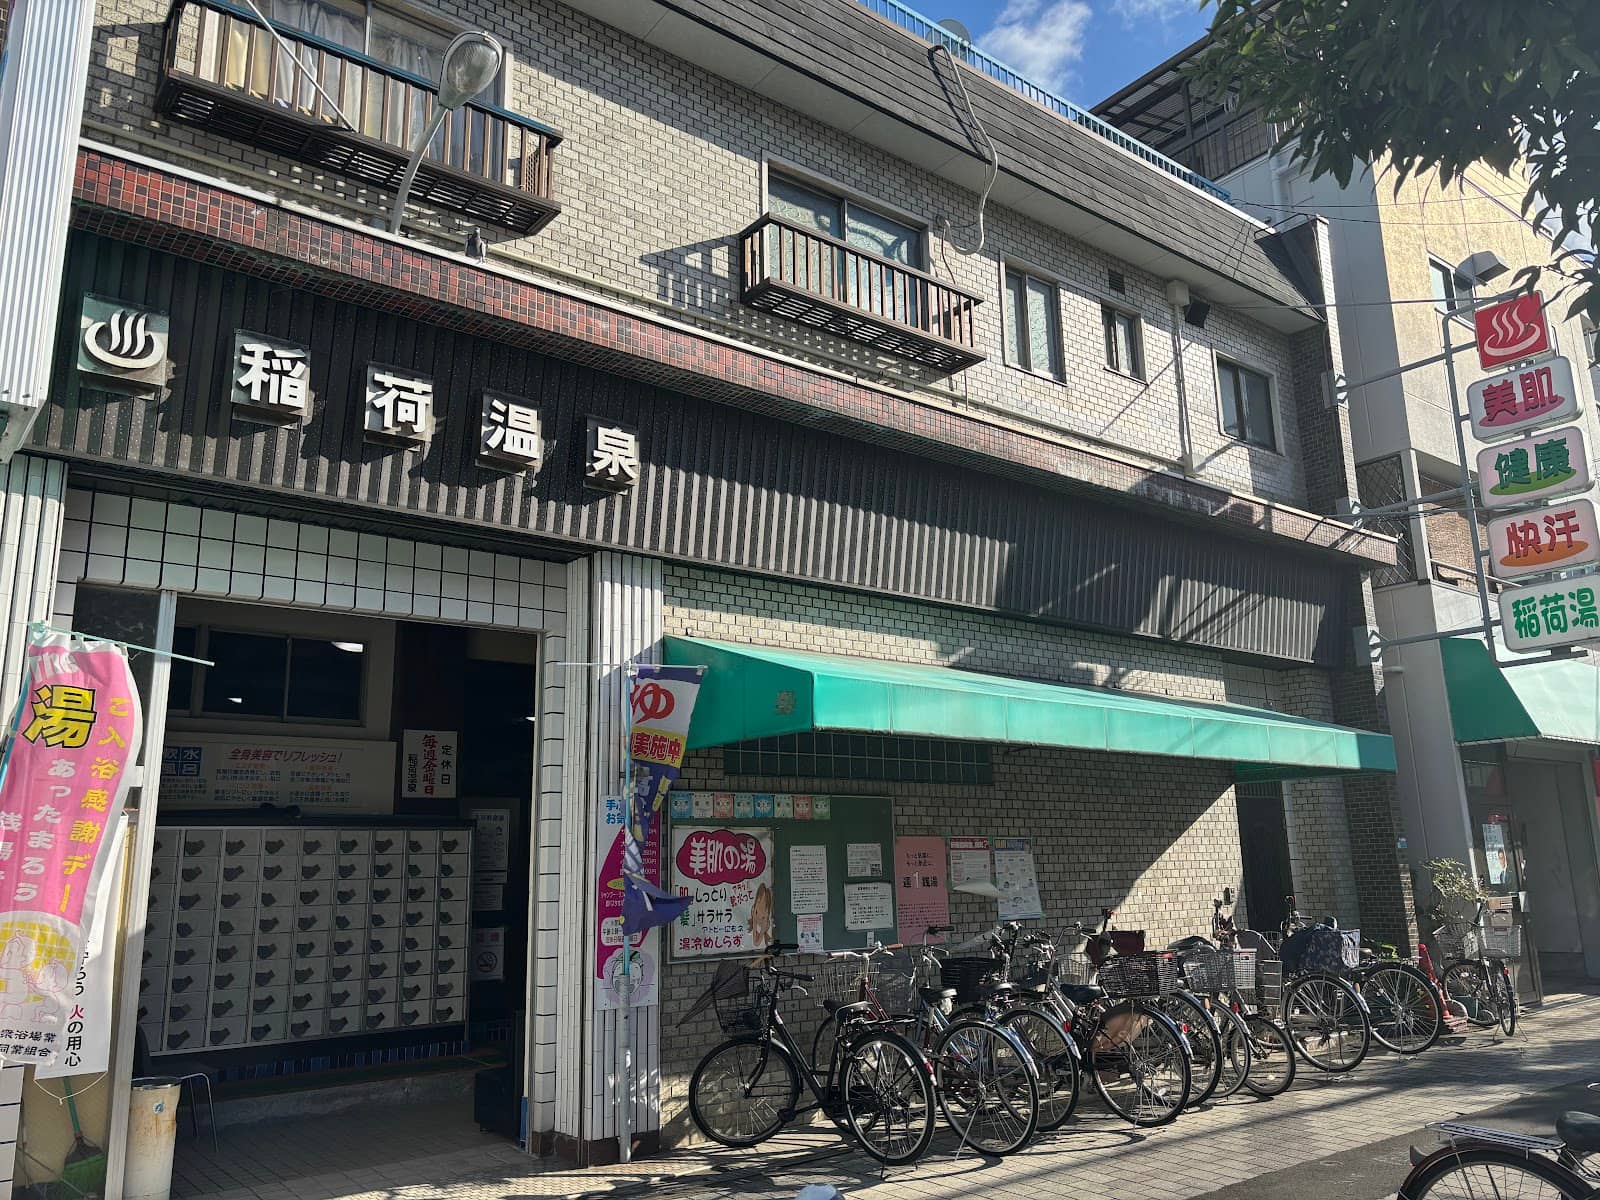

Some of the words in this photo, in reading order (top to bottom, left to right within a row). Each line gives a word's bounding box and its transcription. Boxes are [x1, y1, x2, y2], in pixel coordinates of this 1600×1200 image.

[237, 341, 640, 480] 稲荷温泉
[1482, 366, 1558, 423] 美肌
[1494, 437, 1573, 491] 健康
[1506, 509, 1581, 560] 快汗
[1511, 586, 1600, 640] 稲荷湯
[21, 684, 98, 749] 湯
[630, 682, 675, 724] ゆ
[440, 744, 453, 785] 定休日
[13, 758, 77, 902] あったまろう
[689, 836, 757, 876] 美肌の湯
[679, 934, 744, 952] 湯冷めしらず
[64, 1004, 85, 1067] 火の用心
